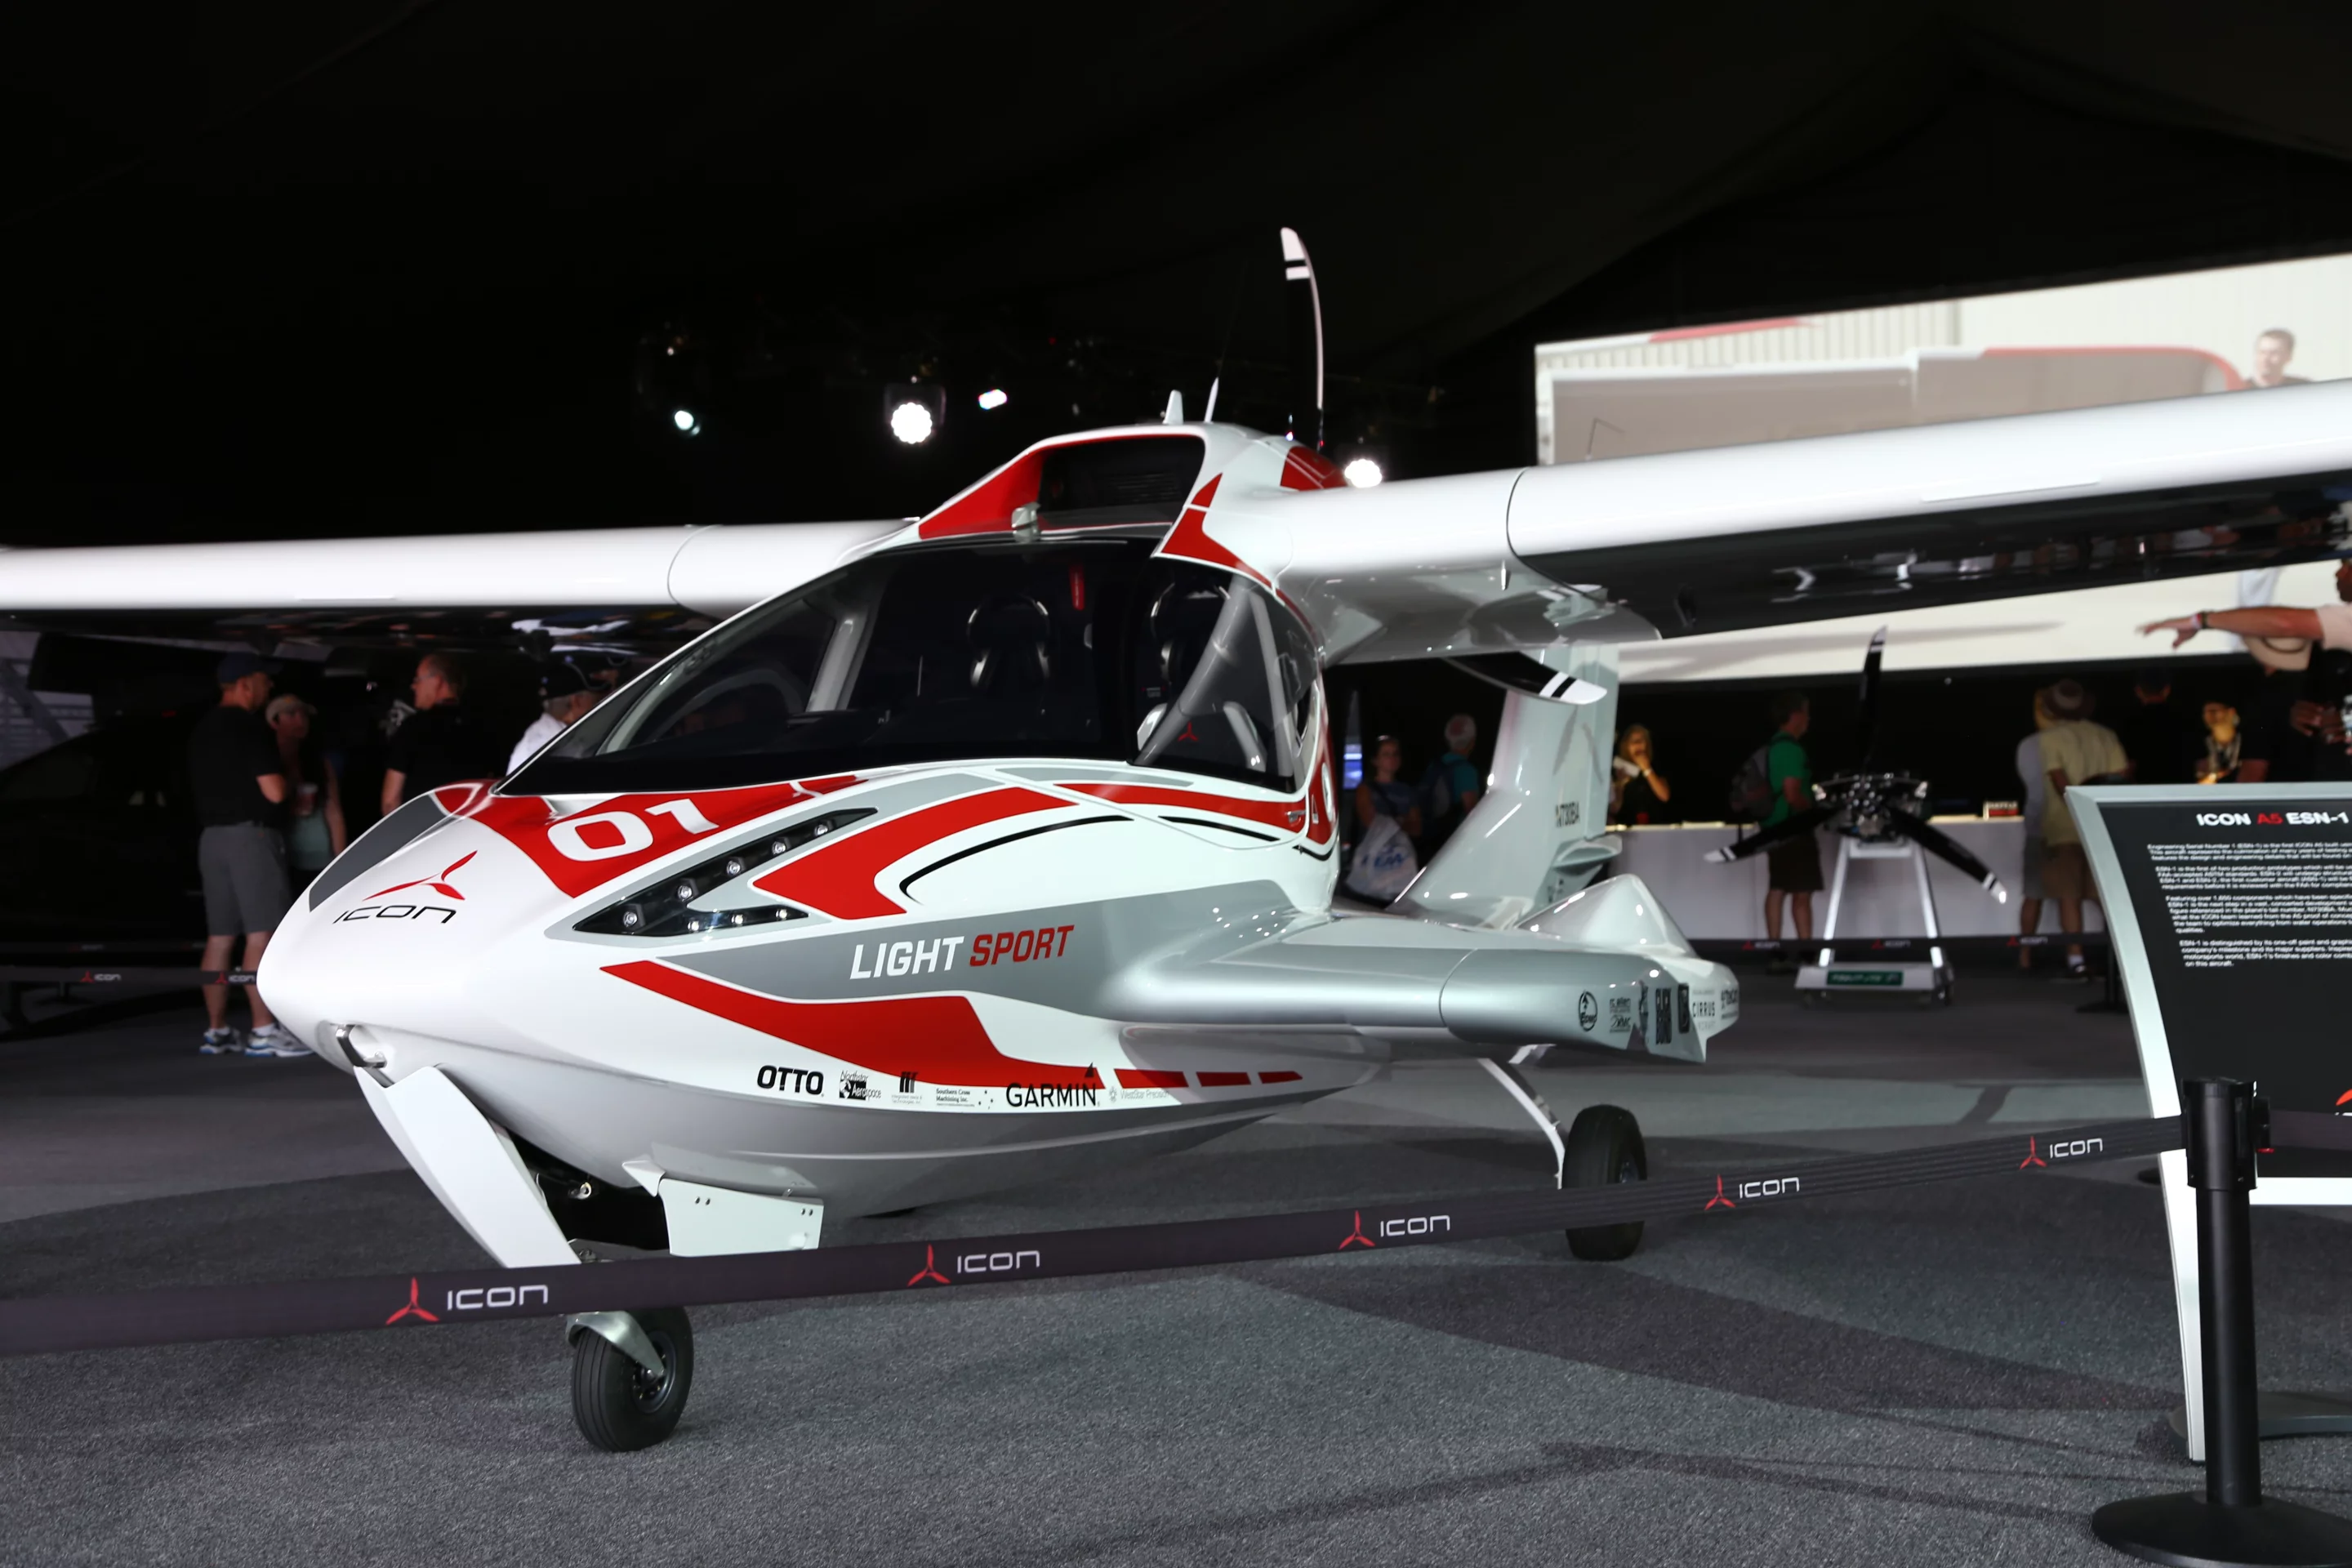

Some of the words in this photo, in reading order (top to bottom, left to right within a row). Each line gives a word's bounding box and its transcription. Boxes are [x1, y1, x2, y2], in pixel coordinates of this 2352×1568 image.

[548, 799, 719, 862] 01
[2196, 813, 2252, 826] ICON
[2257, 813, 2283, 825] A5
[2286, 811, 2349, 825] ESN-1
[849, 936, 964, 980] LIGHT
[969, 924, 1075, 967] SPORT
[1693, 1001, 1715, 1018] CIRRUS
[757, 1065, 824, 1095] OTTO
[852, 1083, 882, 1101] Aerospace
[1006, 1083, 1096, 1107] GARMIN
